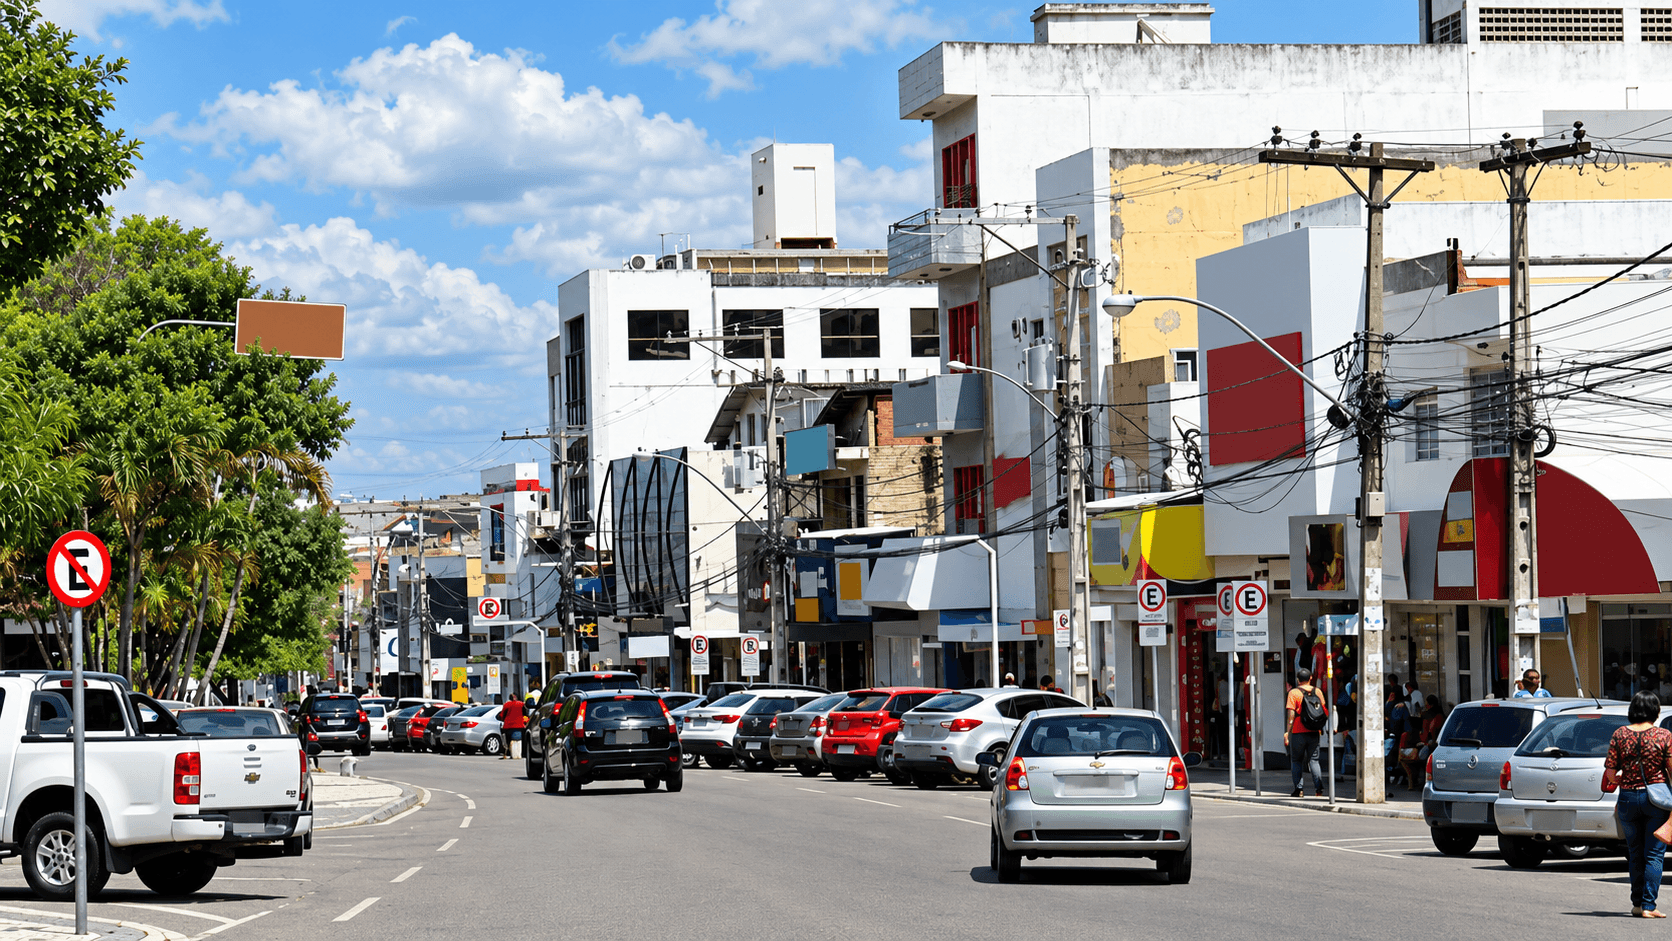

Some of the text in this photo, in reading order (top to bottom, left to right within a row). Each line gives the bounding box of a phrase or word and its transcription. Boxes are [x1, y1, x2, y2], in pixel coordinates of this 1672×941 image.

[68, 548, 90, 591] E
[1146, 588, 1158, 605] E
[1225, 592, 1231, 609] E
[1245, 590, 1257, 609] E
[696, 640, 704, 650] E
